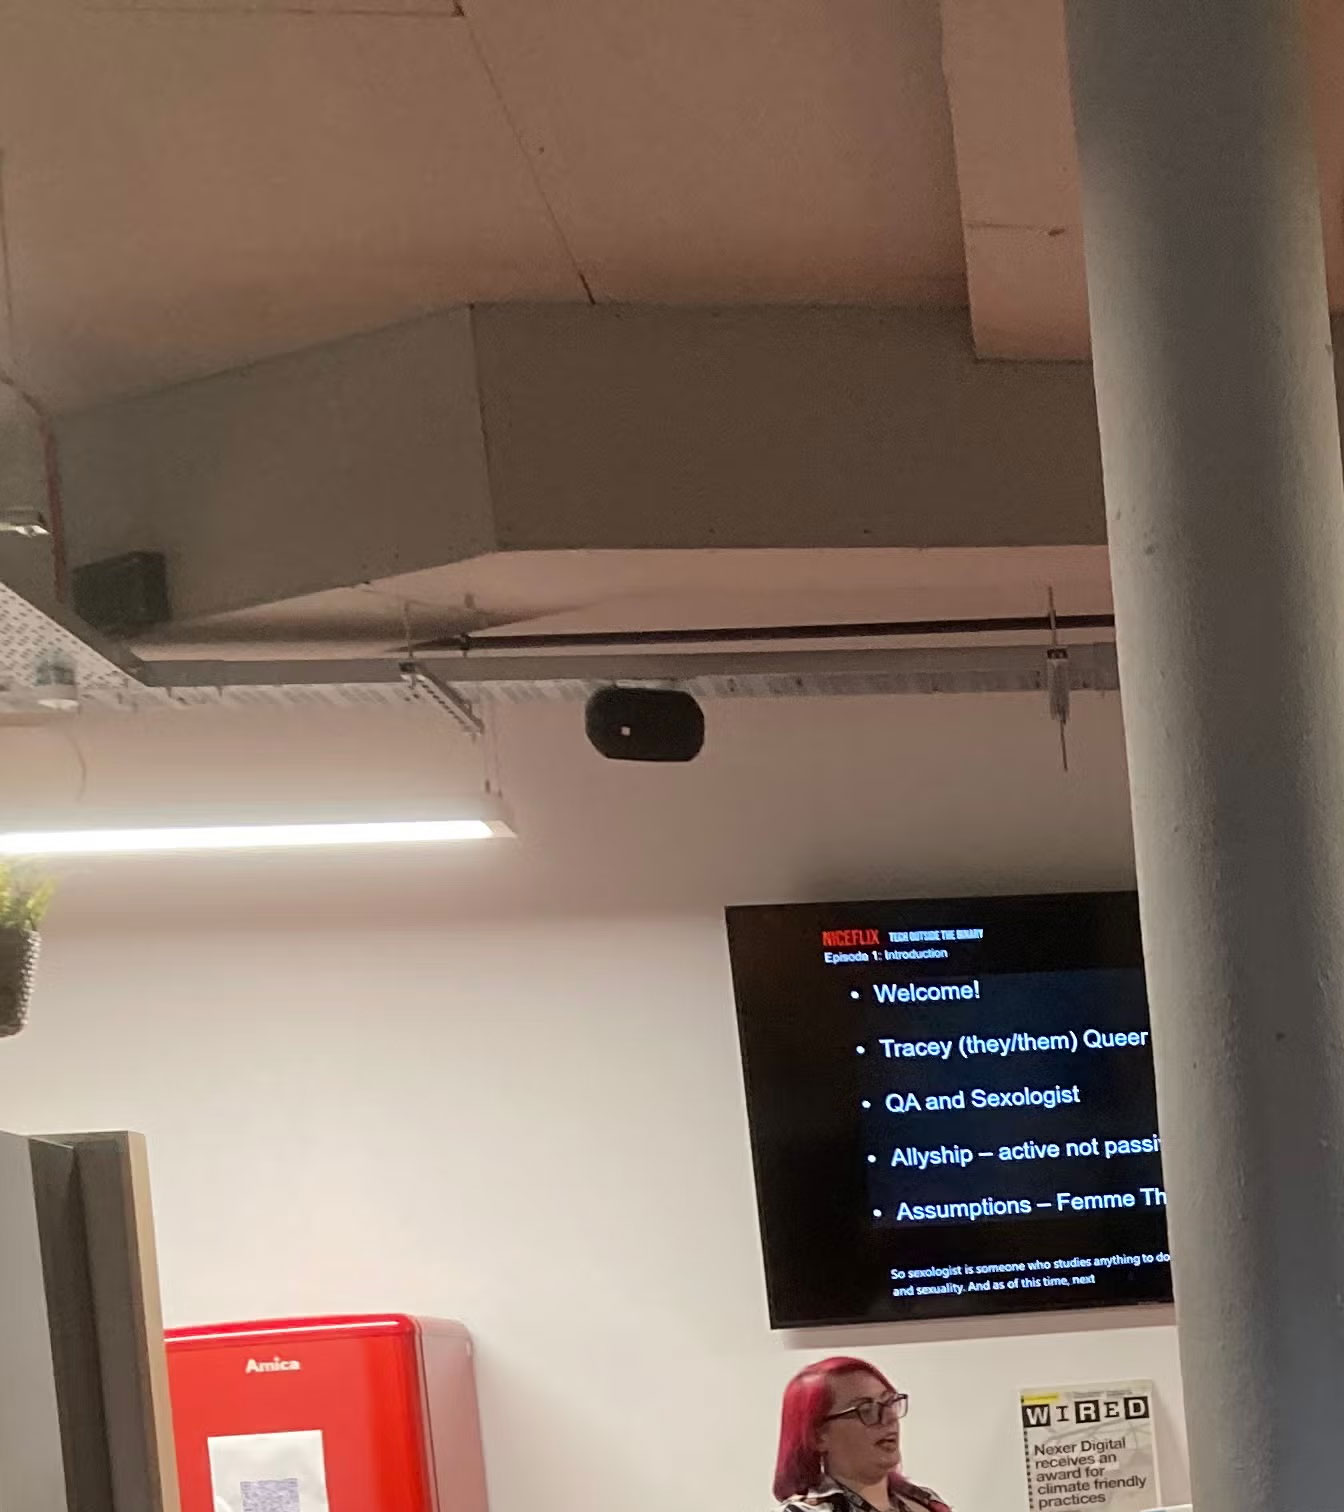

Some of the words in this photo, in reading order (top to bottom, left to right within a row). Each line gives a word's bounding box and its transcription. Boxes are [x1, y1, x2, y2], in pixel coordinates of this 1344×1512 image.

[822, 928, 880, 946] NICEFLIX
[824, 951, 869, 964] Episode
[872, 951, 882, 961] 1:
[884, 948, 948, 961] Introduction
[873, 980, 980, 1003] Welcome!
[879, 1038, 952, 1060] Tracey
[958, 1031, 1078, 1058] (they/them)
[1083, 1029, 1149, 1049] Queer
[885, 1092, 922, 1113] QA
[925, 1091, 965, 1111] and
[971, 1085, 1080, 1109] Sexologist
[891, 1144, 973, 1170] Allyship
[998, 1139, 1060, 1160] active
[1066, 1137, 1099, 1157] not
[1104, 1133, 1161, 1159] passi
[896, 1197, 1032, 1222] Assumptions
[1057, 1191, 1136, 1212] Femme
[890, 1268, 906, 1279] So
[908, 1265, 962, 1280] sexologist
[964, 1263, 974, 1275] is
[976, 1261, 1025, 1274] someone
[1027, 1259, 1051, 1271] who
[1053, 1256, 1092, 1269] studies
[1093, 1253, 1141, 1268] anything
[1142, 1253, 1154, 1264] to
[1155, 1251, 1171, 1263] do
[892, 1285, 915, 1297] and
[916, 1281, 965, 1297] sexuality.
[967, 1280, 991, 1292] And
[992, 1280, 1005, 1290] as
[1006, 1277, 1019, 1289] of
[1021, 1276, 1042, 1289] this
[1042, 1275, 1070, 1289] time,
[1071, 1274, 1096, 1286] next
[244, 1356, 301, 1375] Amica
[1022, 1396, 1149, 1428] WIRED
[1034, 1443, 1077, 1456] Nexer
[1081, 1437, 1126, 1453] Digital
[1035, 1455, 1096, 1469] receives
[1099, 1453, 1117, 1464] an
[1036, 1468, 1081, 1482] award
[1085, 1466, 1105, 1478] for
[1037, 1481, 1090, 1495] climate
[1094, 1475, 1147, 1489] friendly
[1038, 1493, 1106, 1511] practices
